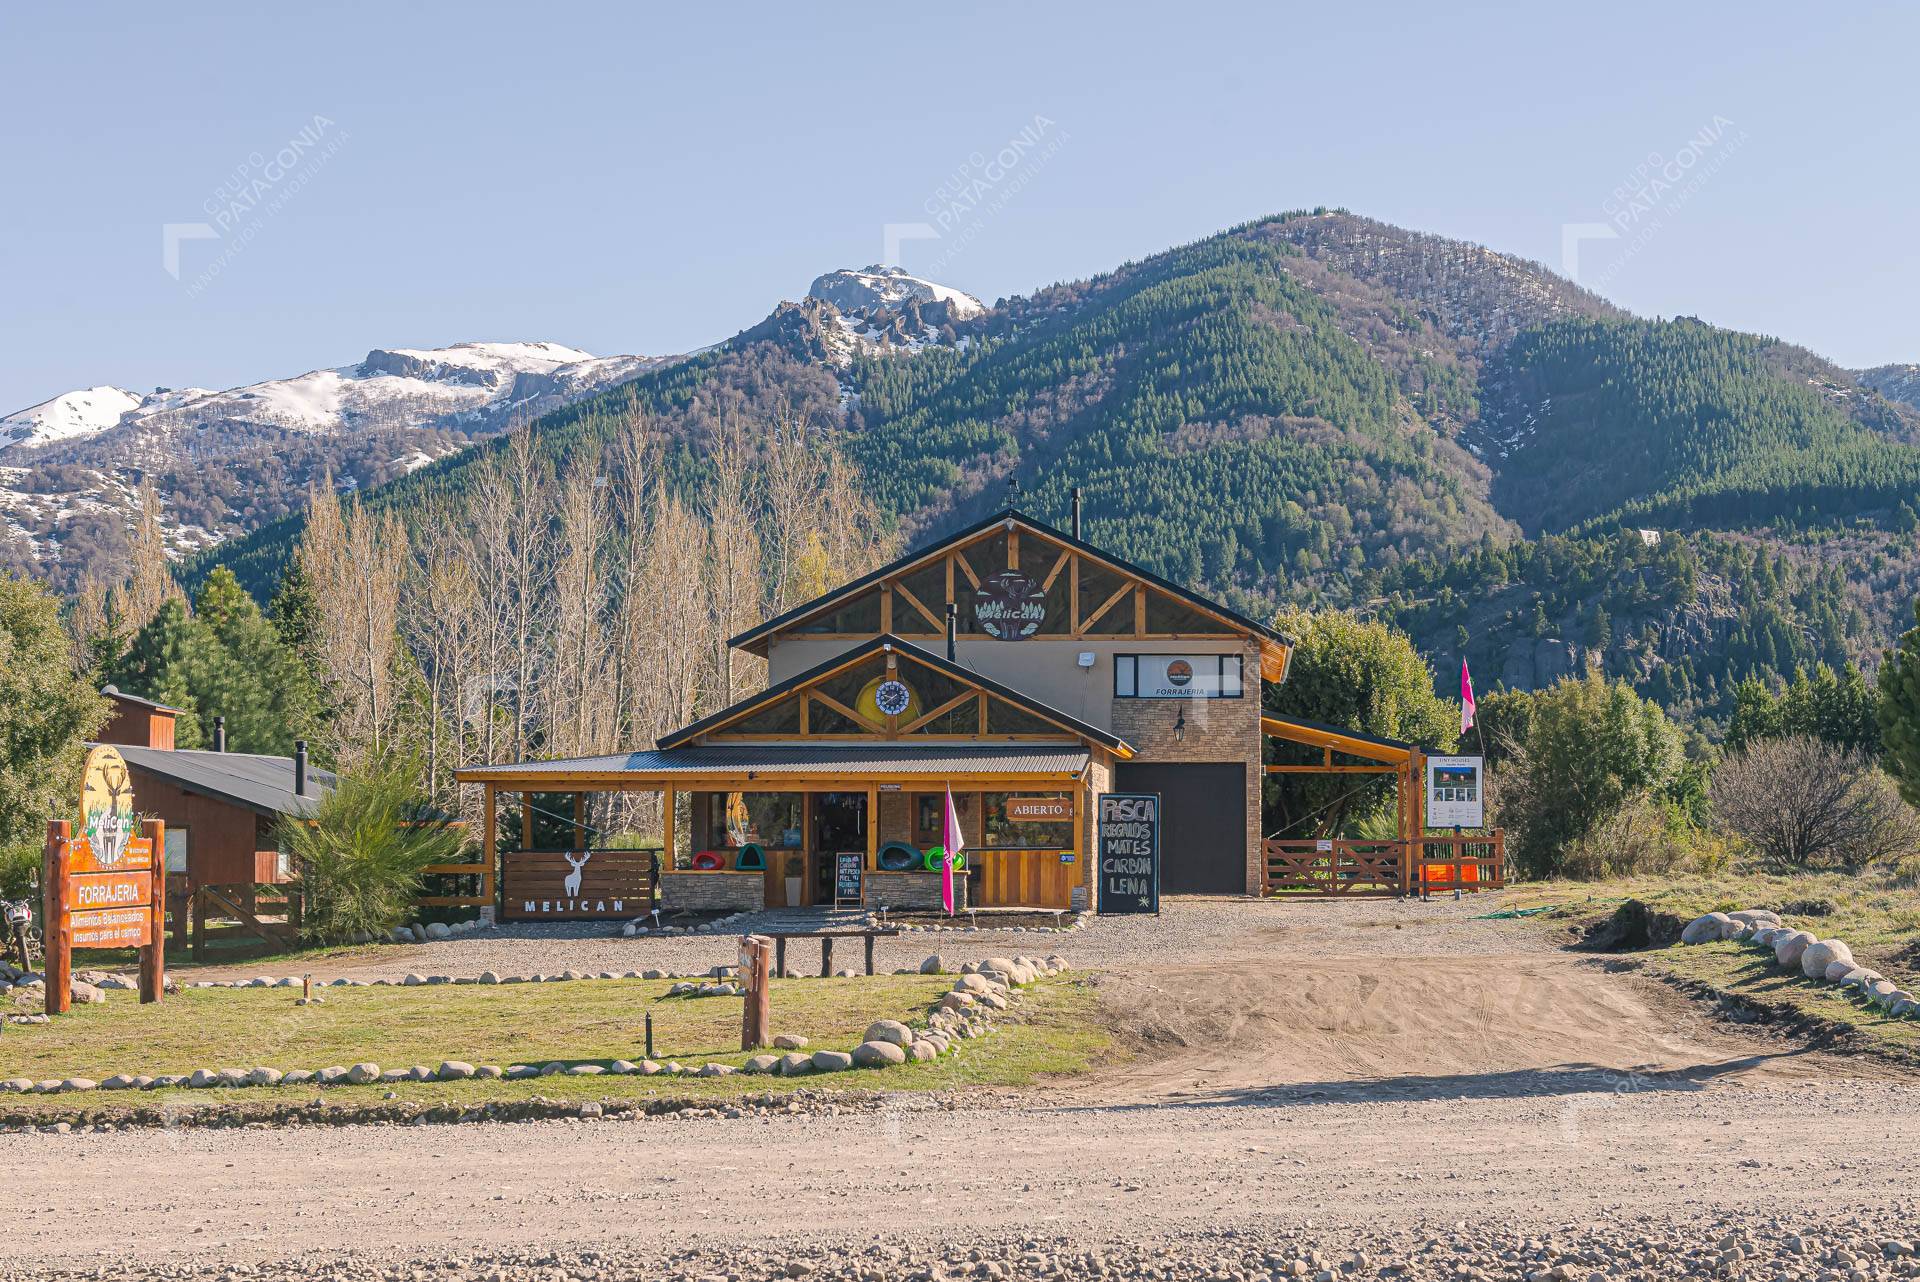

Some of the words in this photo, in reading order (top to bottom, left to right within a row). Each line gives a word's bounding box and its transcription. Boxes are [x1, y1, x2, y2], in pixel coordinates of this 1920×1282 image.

[1015, 805, 1062, 815] ABIERTO
[1102, 798, 1155, 822] PESCA
[1102, 823, 1151, 839] REGALOS
[1107, 840, 1151, 855] MATES
[1102, 857, 1152, 875] CARBON
[79, 884, 139, 904] FORRAJERIA
[525, 900, 623, 912] MELICAN
[71, 914, 102, 927] Alimentos
[103, 911, 143, 925] Balanceados
[74, 931, 99, 943] Insumos
[99, 931, 113, 943] para
[121, 928, 141, 940] campo
